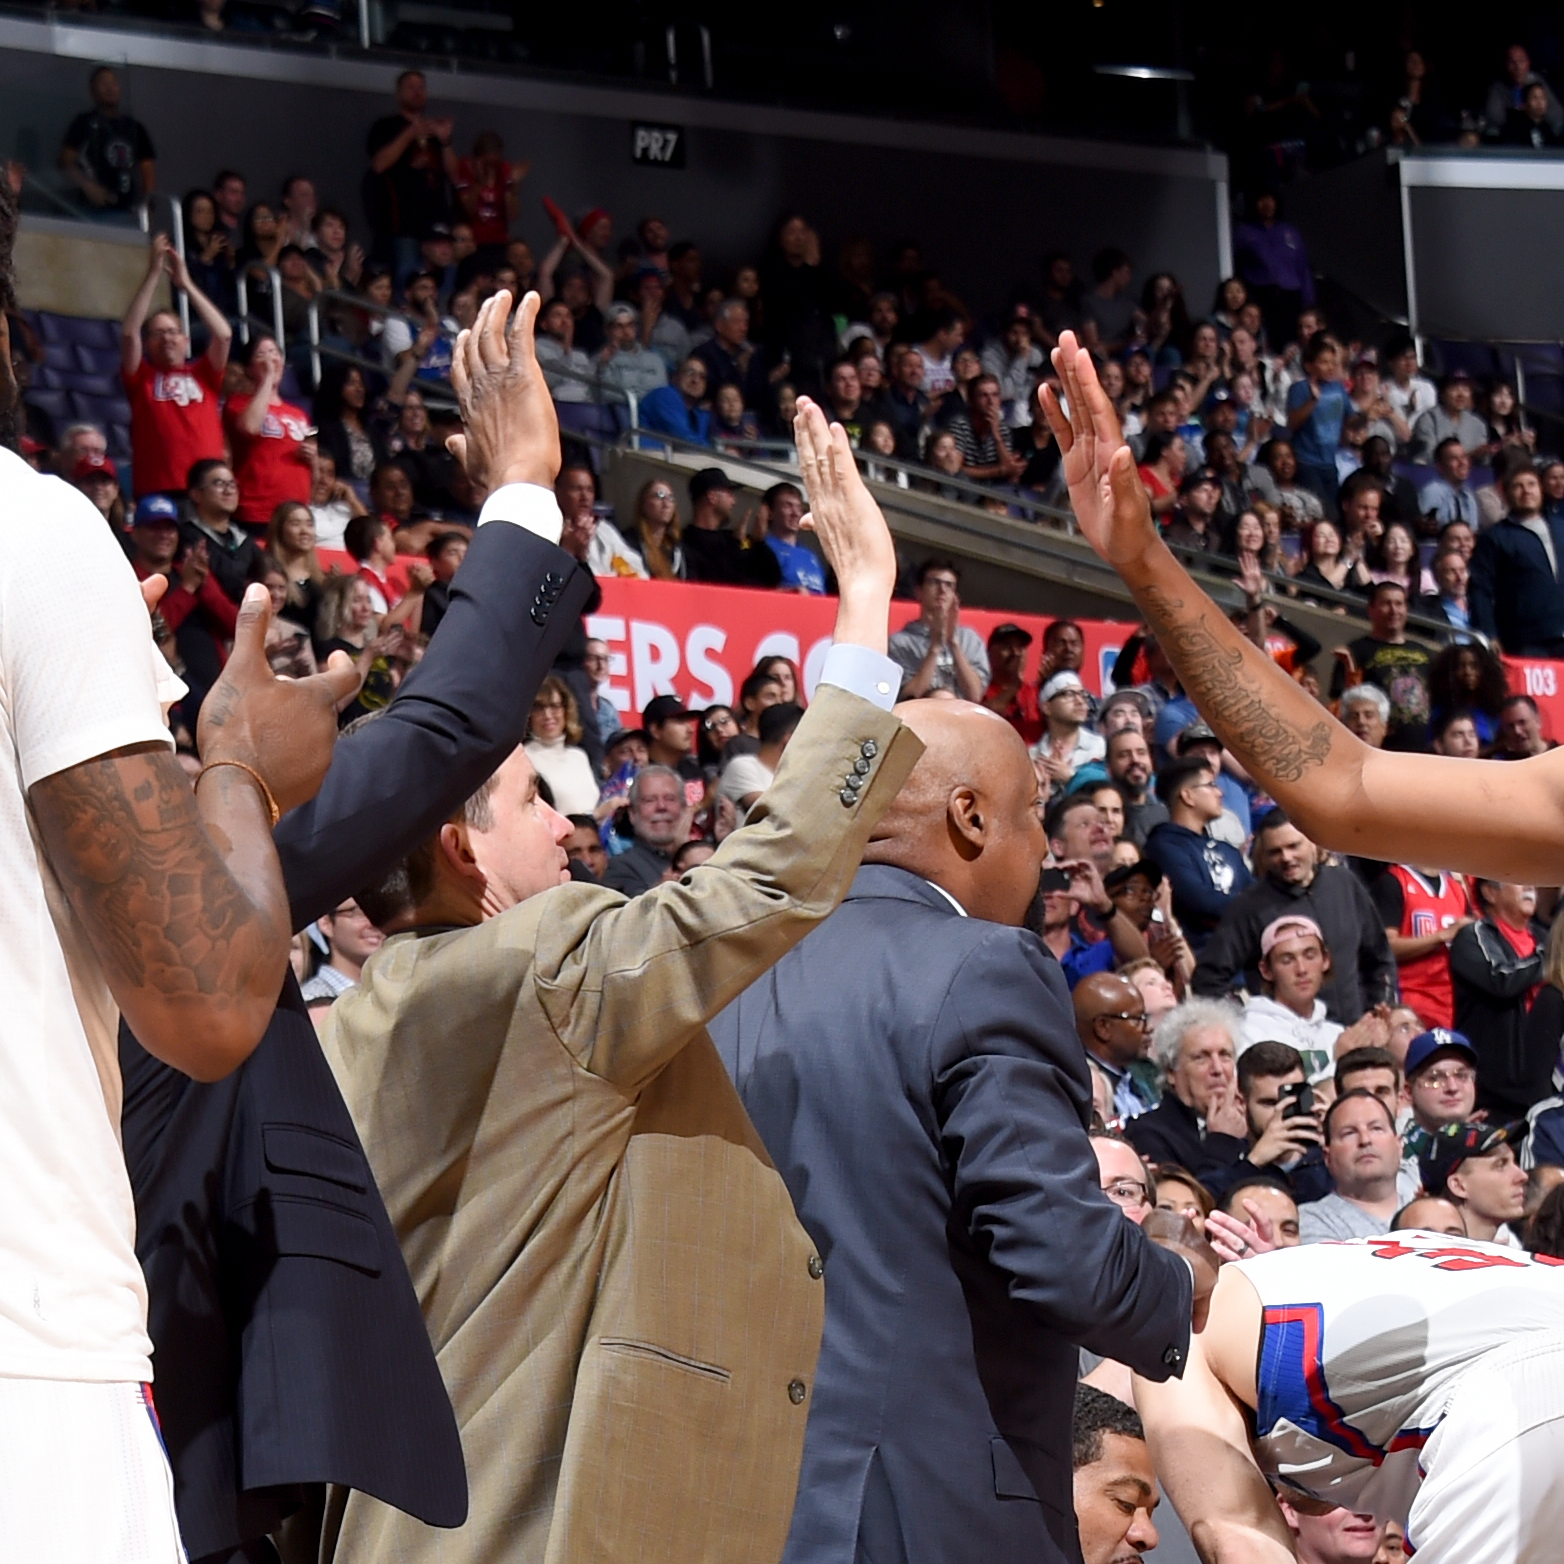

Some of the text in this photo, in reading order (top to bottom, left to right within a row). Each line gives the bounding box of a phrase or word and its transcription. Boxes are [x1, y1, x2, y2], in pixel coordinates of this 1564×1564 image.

[634, 128, 678, 163] PR7
[585, 615, 734, 714] ERS
[1524, 666, 1557, 697] 103
